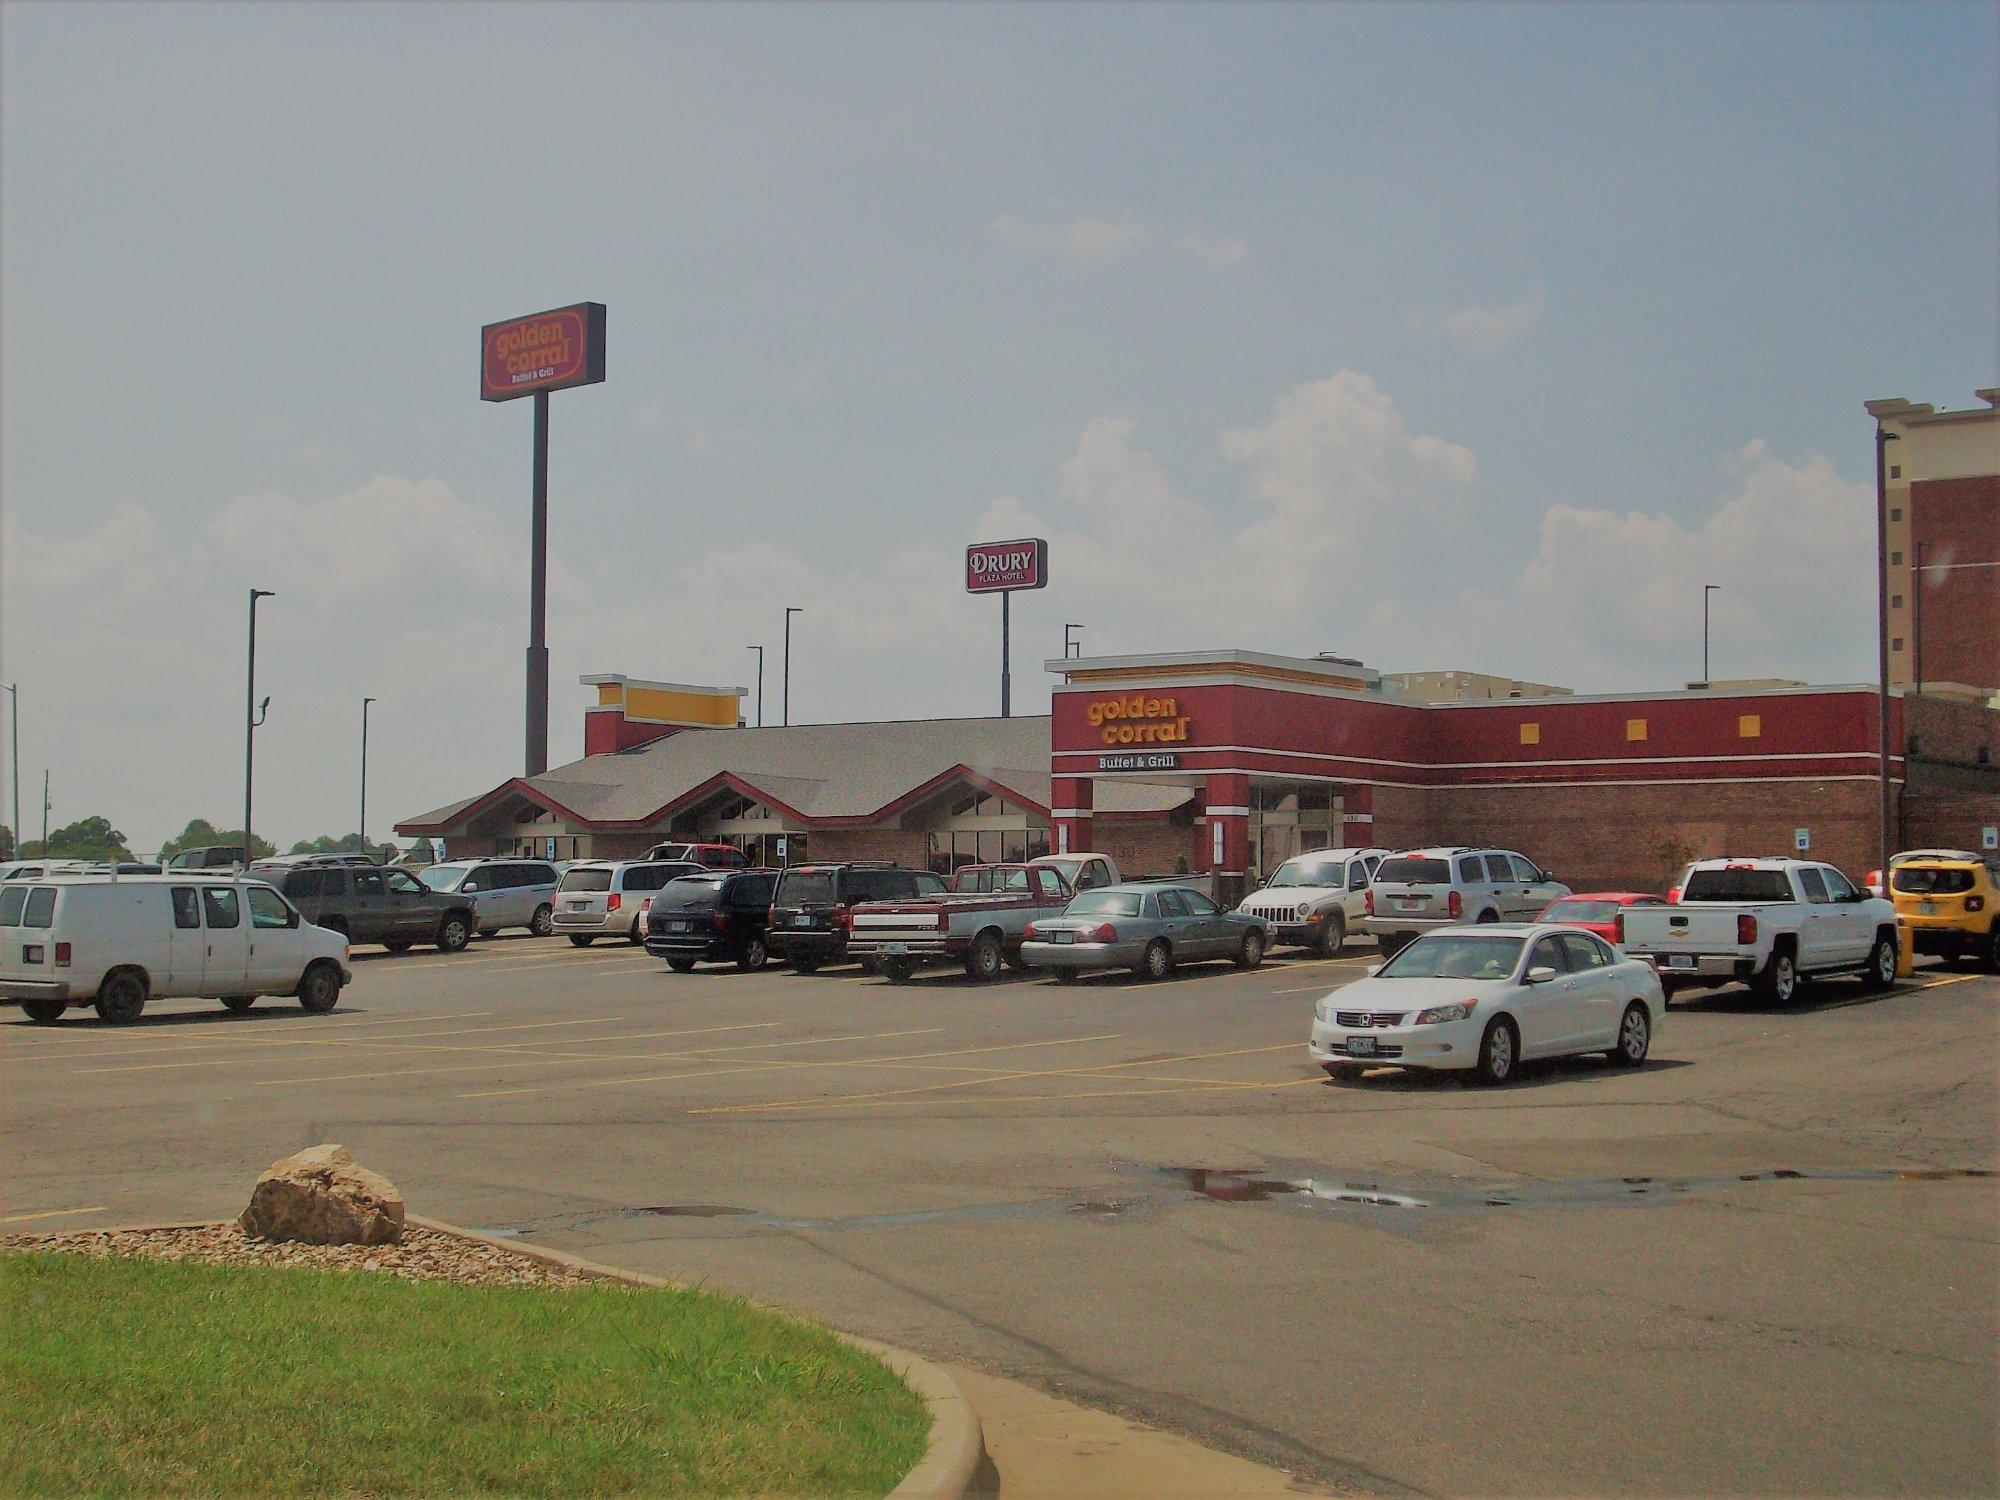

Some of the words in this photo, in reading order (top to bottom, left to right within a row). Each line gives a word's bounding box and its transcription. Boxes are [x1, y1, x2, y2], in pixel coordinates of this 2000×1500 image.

[497, 321, 563, 359] golden
[507, 338, 571, 373] corral
[970, 551, 1032, 574] DRURY
[979, 574, 1001, 583] PLAZA
[1001, 572, 1025, 581] HOTEL
[1086, 694, 1178, 727] golden
[1102, 716, 1191, 744] corral
[1099, 757, 1134, 769] Buffet
[1136, 757, 1145, 768] &
[1148, 755, 1175, 768] Grill
